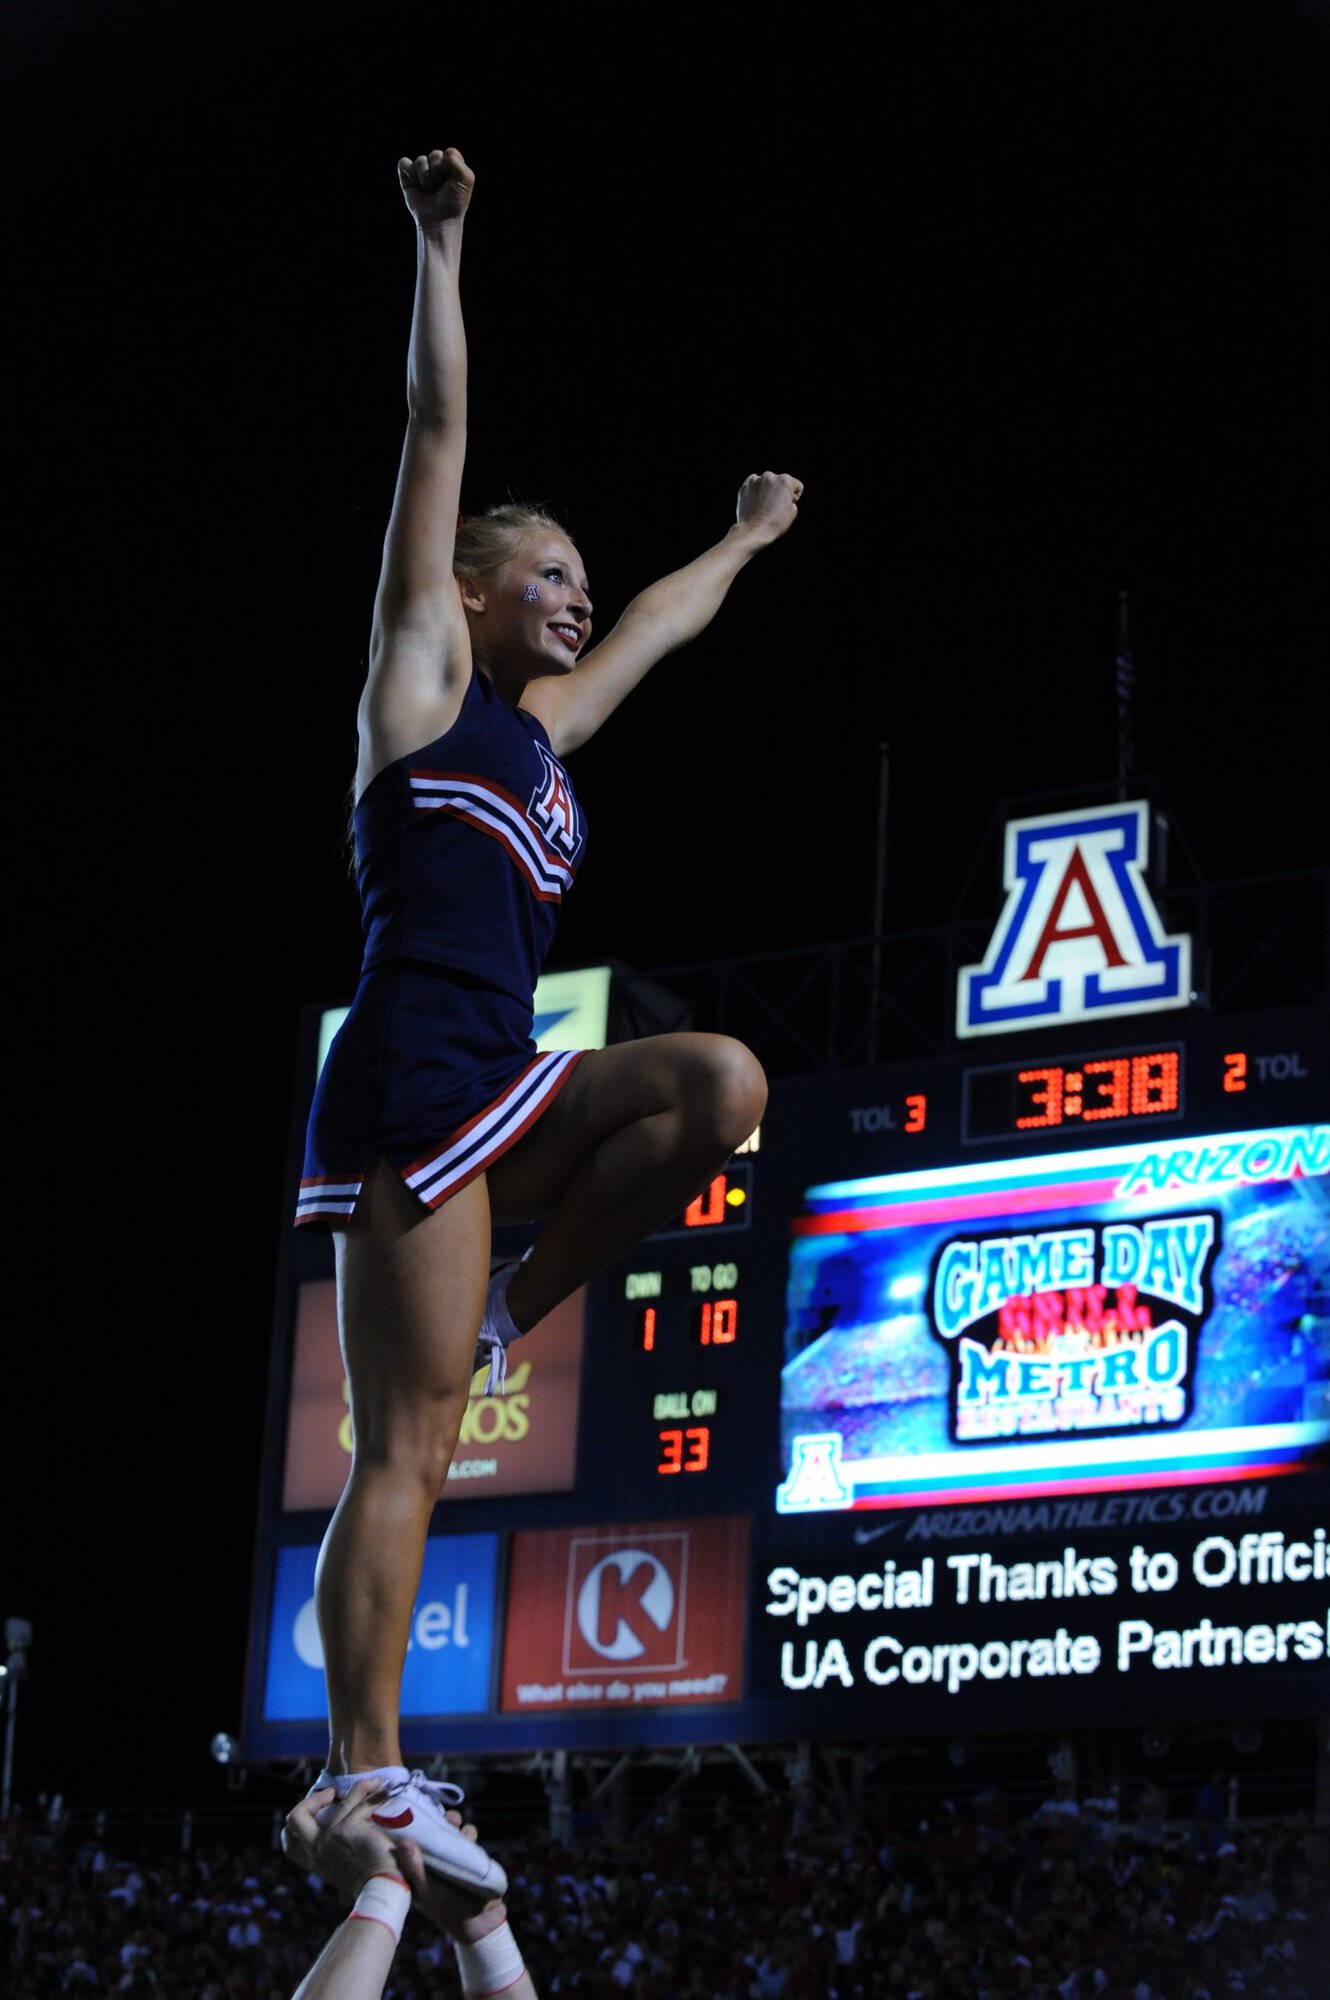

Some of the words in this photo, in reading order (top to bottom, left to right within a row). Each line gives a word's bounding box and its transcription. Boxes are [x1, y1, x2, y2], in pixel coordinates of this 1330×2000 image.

[526, 739, 583, 867] A
[955, 800, 1192, 1039] A
[1016, 1051, 1179, 1129] 3:38
[1223, 1053, 1247, 1092] 2
[1255, 1055, 1308, 1081] TOL
[850, 1106, 898, 1133] TOL
[904, 1095, 927, 1133] 3
[690, 1265, 712, 1292] TO
[712, 1262, 738, 1291] GO
[934, 1229, 1094, 1338] GAME
[1101, 1215, 1214, 1315] DAY
[644, 1308, 656, 1351] 1
[700, 1299, 738, 1345] 10
[958, 1320, 1187, 1403] METRO
[653, 1392, 691, 1420] BALL
[691, 1389, 717, 1417] ON
[657, 1427, 709, 1475] 33
[765, 1557, 934, 1627] Special
[947, 1547, 1119, 1604] Thanks
[1129, 1545, 1179, 1593] to
[1192, 1527, 1330, 1589] Offici
[780, 1637, 855, 1690] UA
[863, 1627, 1101, 1694] Corporate
[1116, 1606, 1330, 1673] Partners
